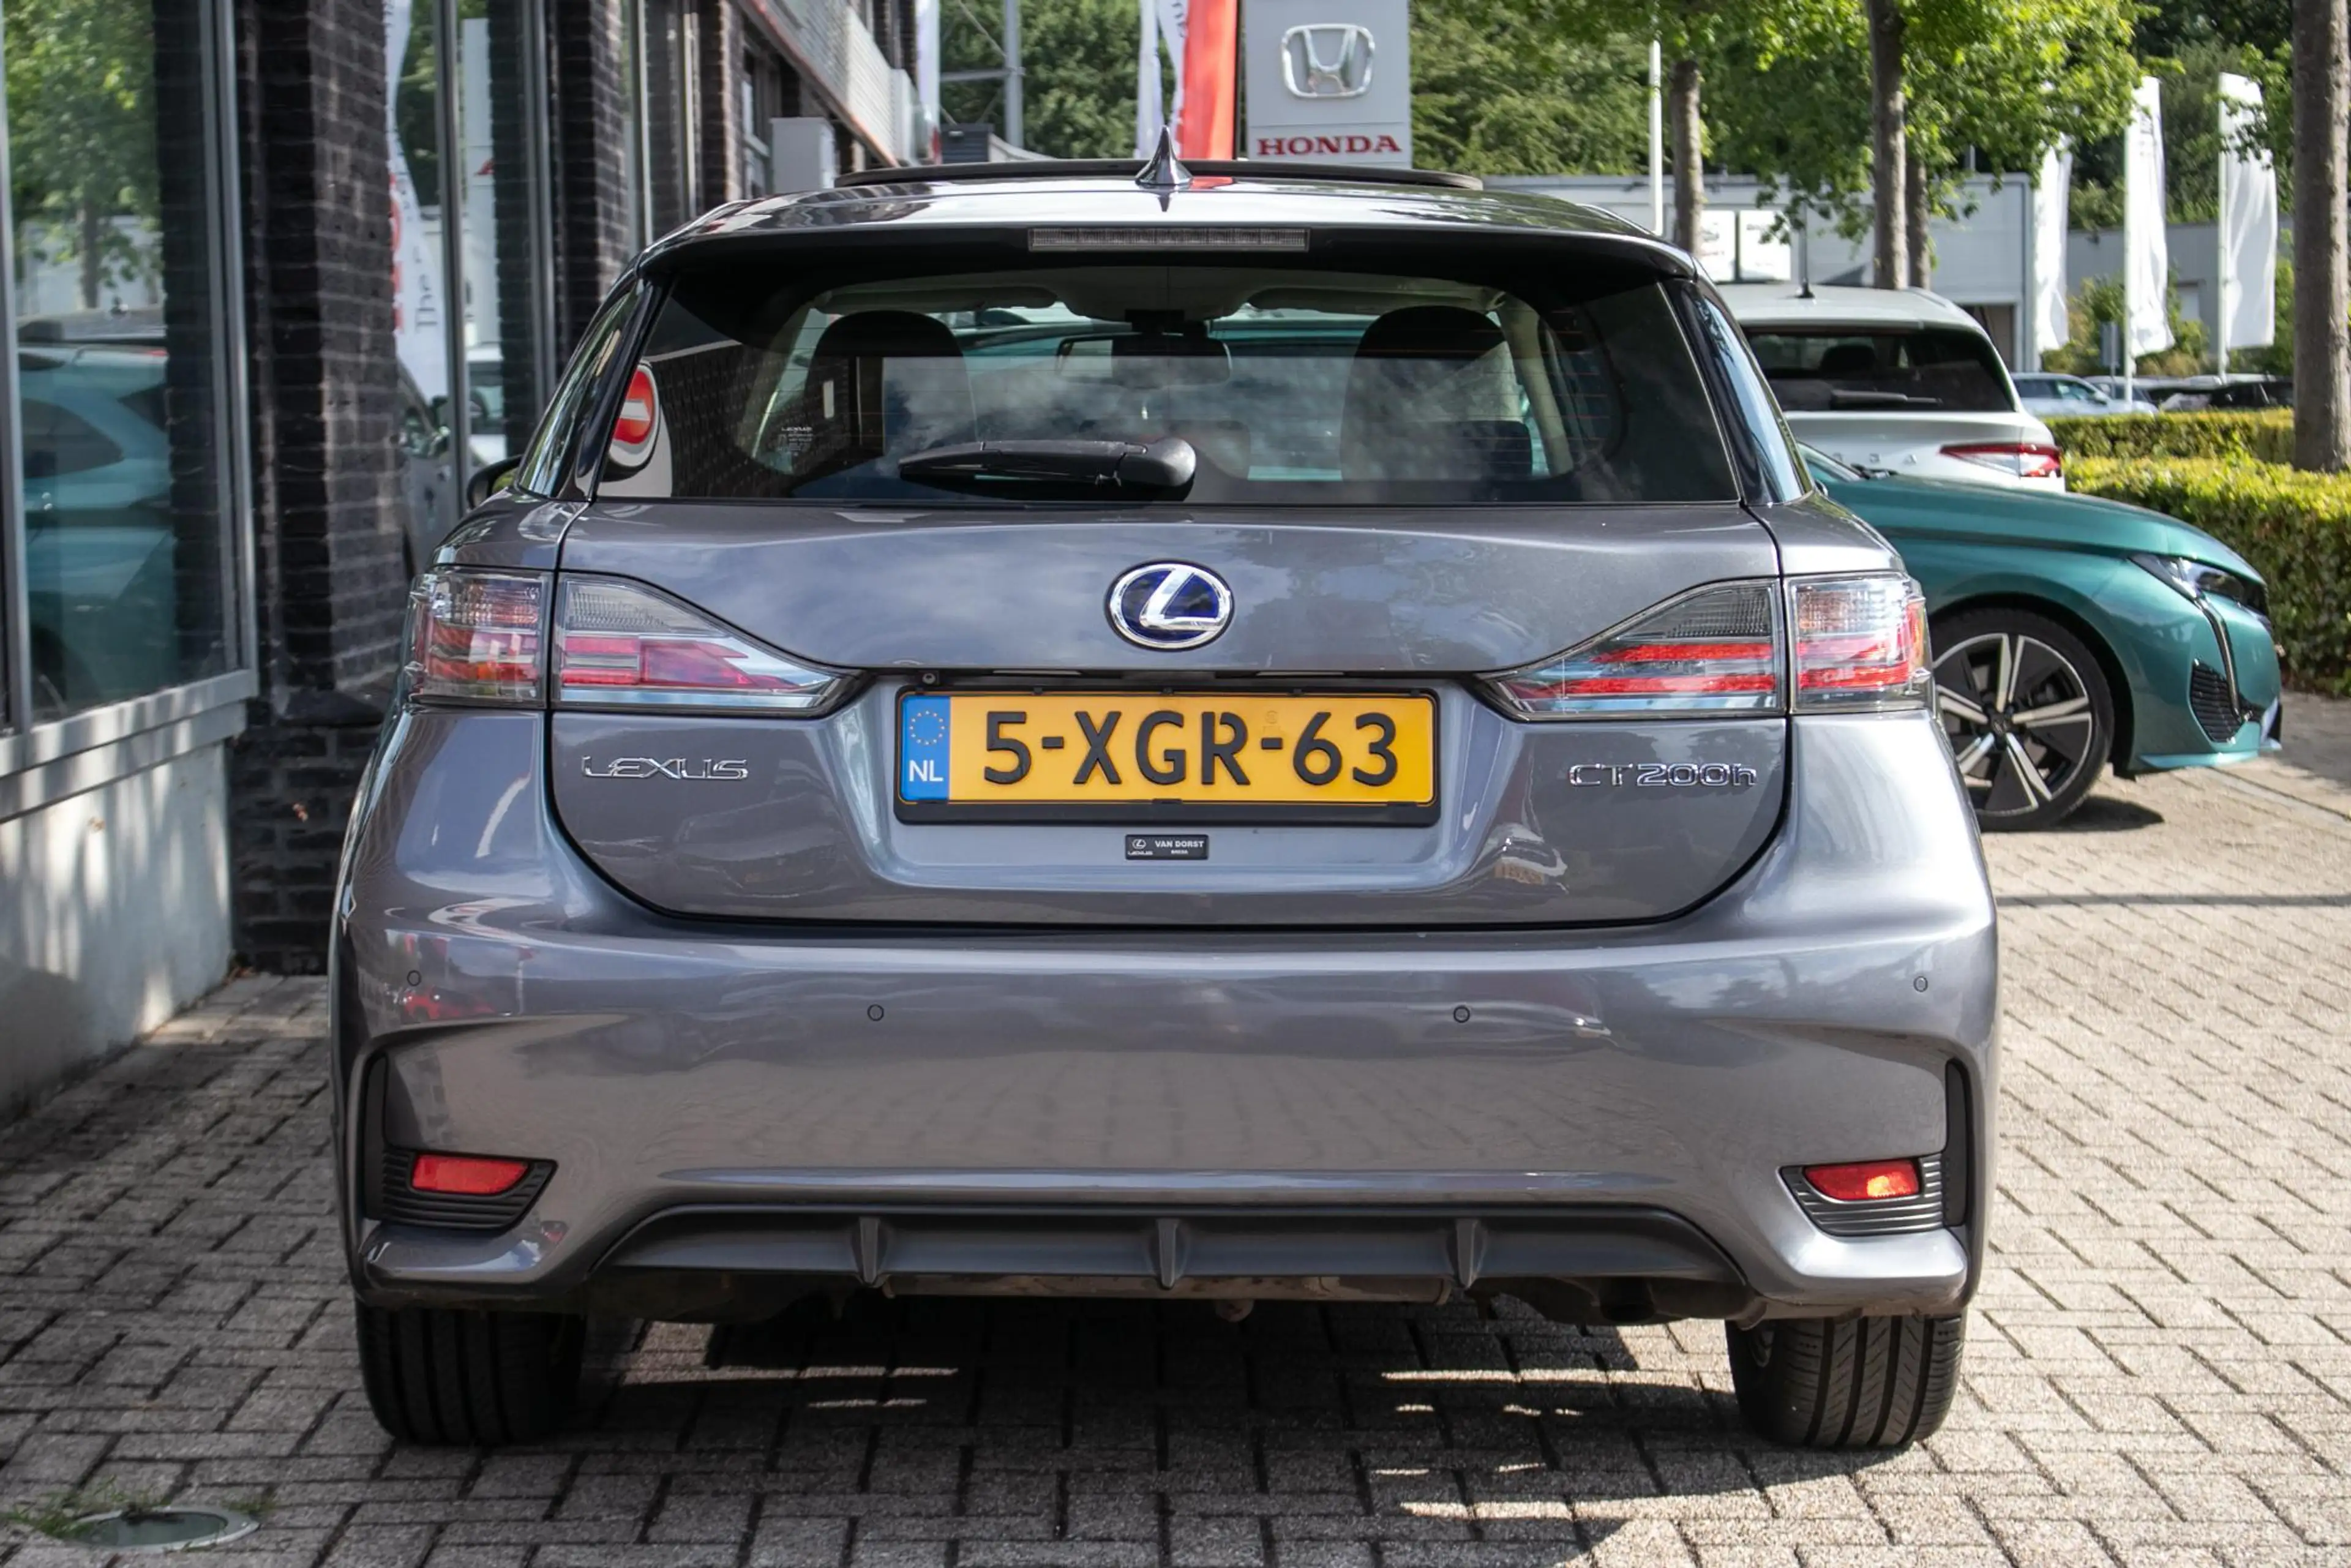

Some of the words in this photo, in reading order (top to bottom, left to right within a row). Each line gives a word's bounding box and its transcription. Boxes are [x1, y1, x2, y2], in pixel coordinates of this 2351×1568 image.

[1257, 135, 1401, 156] HONDA
[984, 710, 1398, 786] 5-XGR-63
[582, 756, 748, 779] LEXUS
[909, 760, 943, 782] NL
[1569, 763, 1757, 786] CT200h
